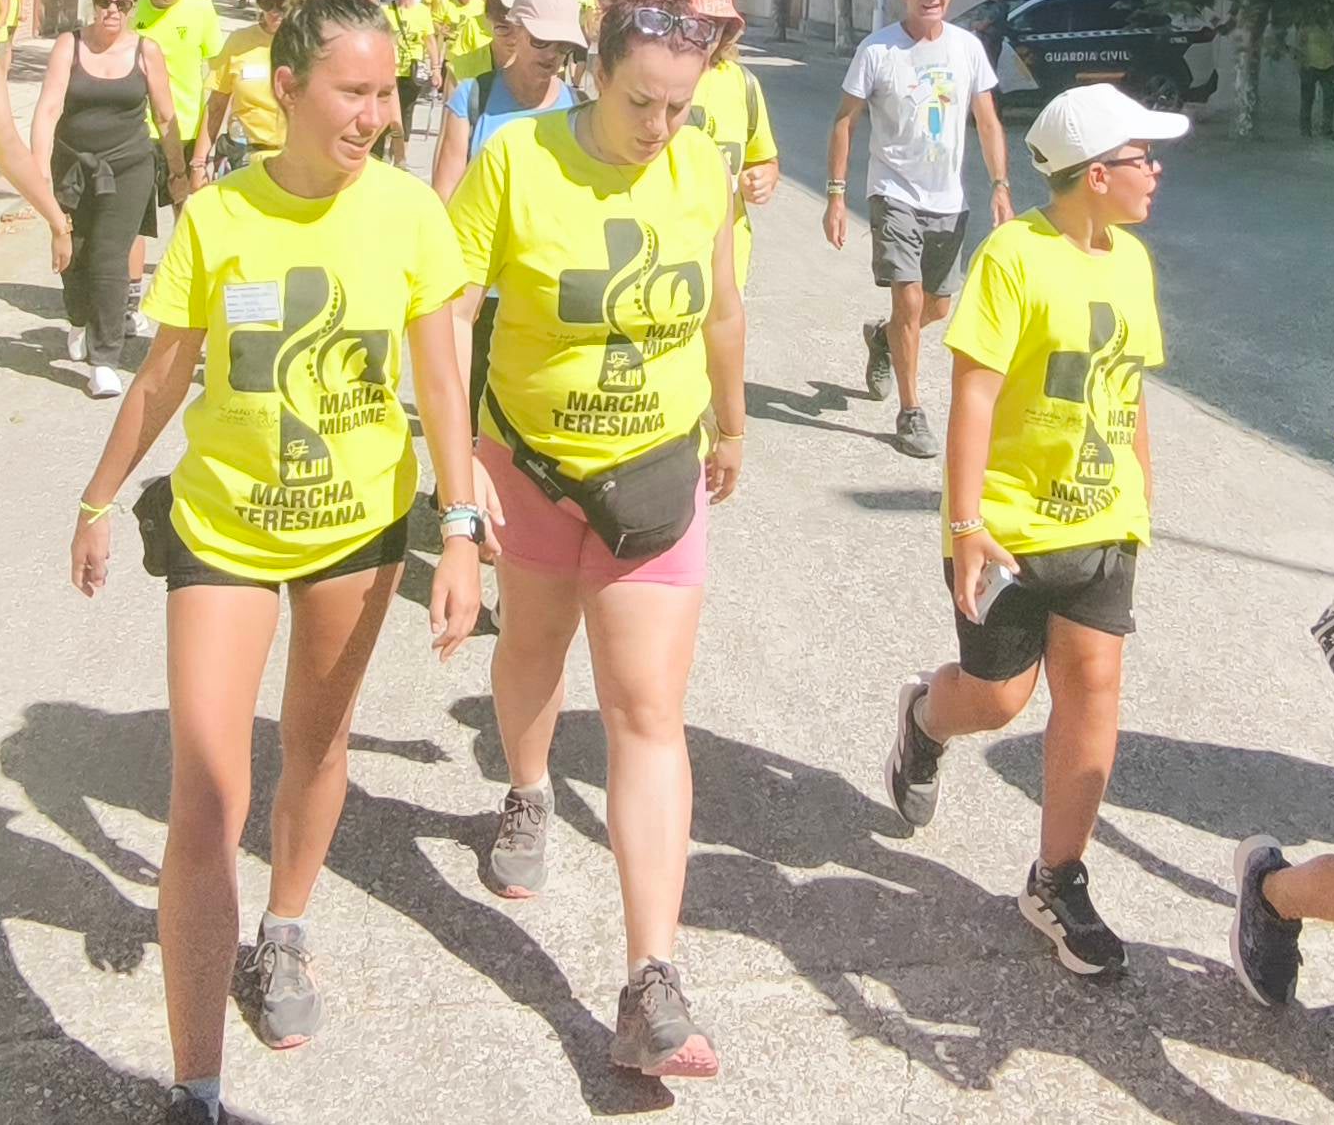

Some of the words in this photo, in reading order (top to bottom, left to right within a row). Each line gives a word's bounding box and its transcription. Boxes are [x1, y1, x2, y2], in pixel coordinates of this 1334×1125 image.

[1044, 51, 1098, 63] GUARDIA
[1099, 50, 1130, 62] CIVIL
[319, 383, 386, 415] MARÍA
[567, 390, 660, 413] MARCHA
[318, 407, 387, 436] MÍRAME
[552, 409, 665, 437] TERESIANA
[250, 480, 353, 509] MARCHA
[234, 501, 367, 532] TERESIANA
